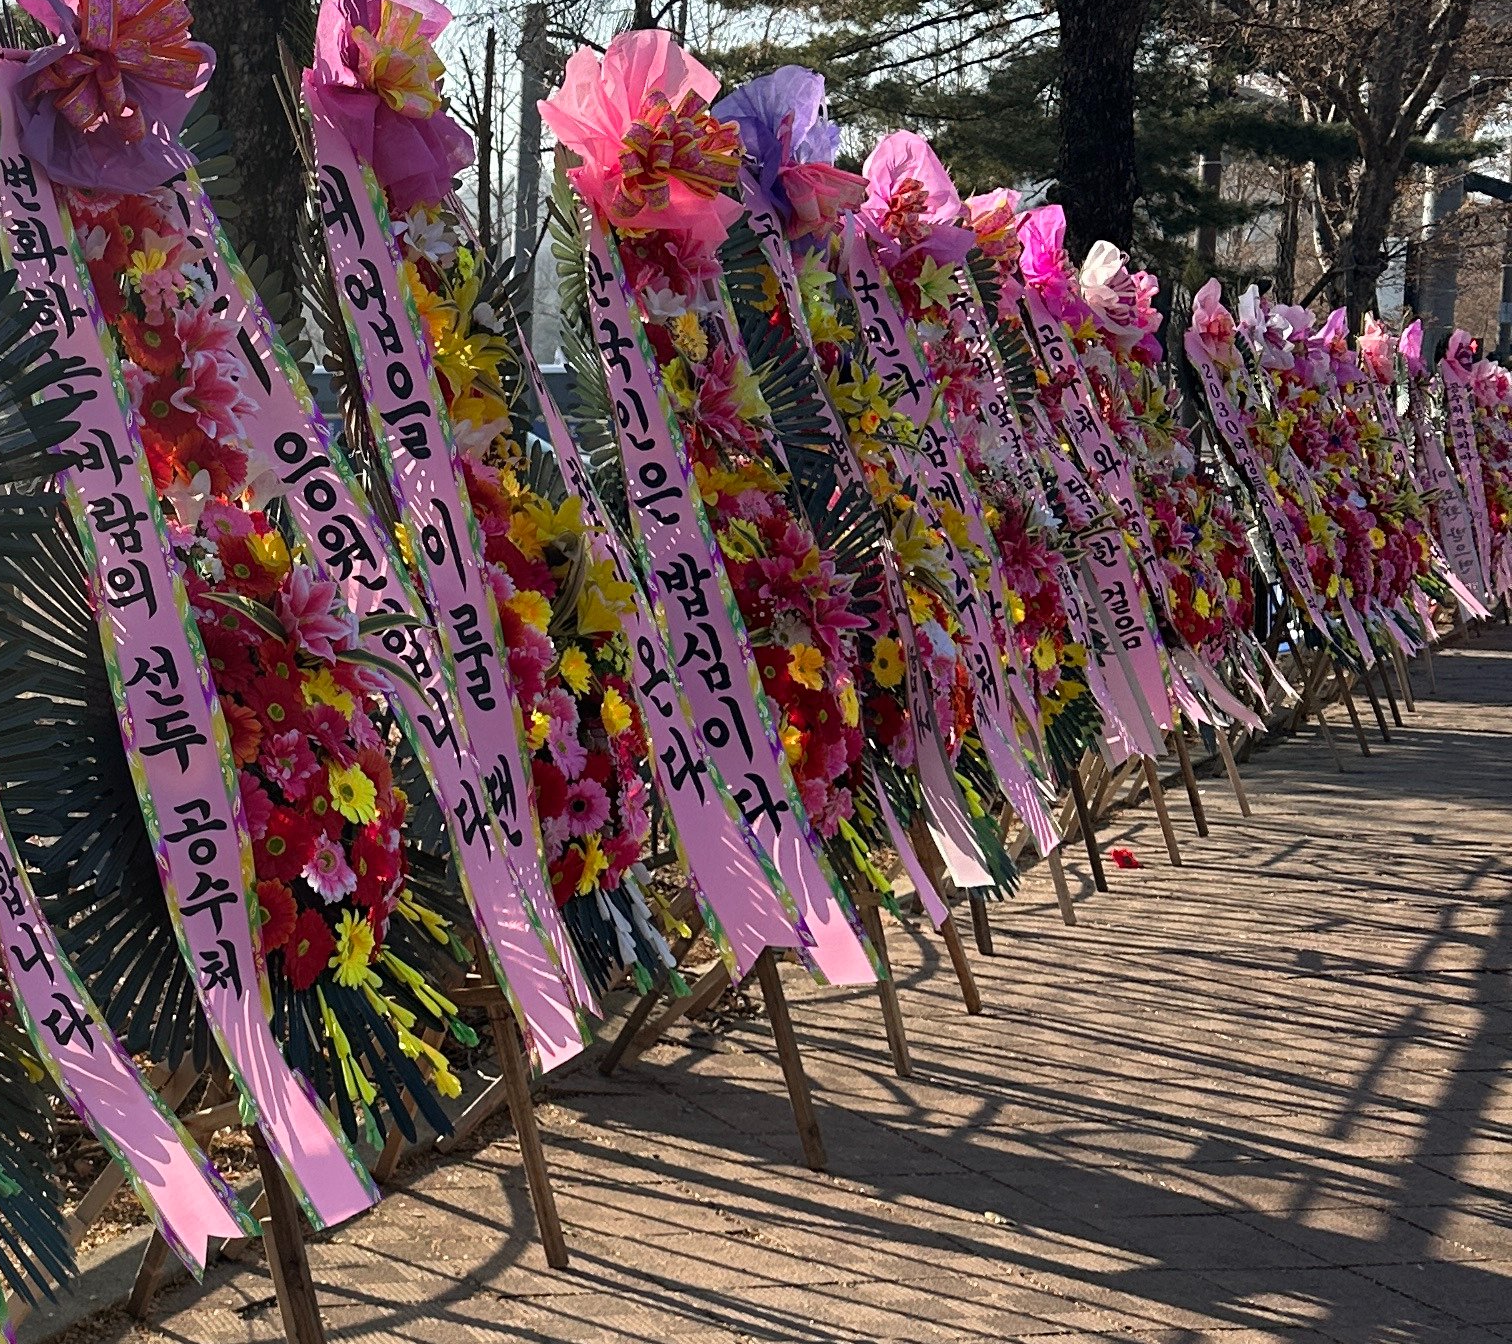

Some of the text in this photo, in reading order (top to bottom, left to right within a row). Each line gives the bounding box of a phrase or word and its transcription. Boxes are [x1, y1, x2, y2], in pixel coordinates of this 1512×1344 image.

[853, 269, 966, 515] 국민과 함께
[1038, 324, 1122, 480] 공수처와
[73, 429, 159, 619] 바람의
[587, 252, 788, 837] 한국인은 밥심이다
[1101, 581, 1145, 652] 걸음
[125, 646, 208, 774] 선두
[274, 430, 492, 862] 응원합니다
[162, 798, 244, 1003] 공수처
